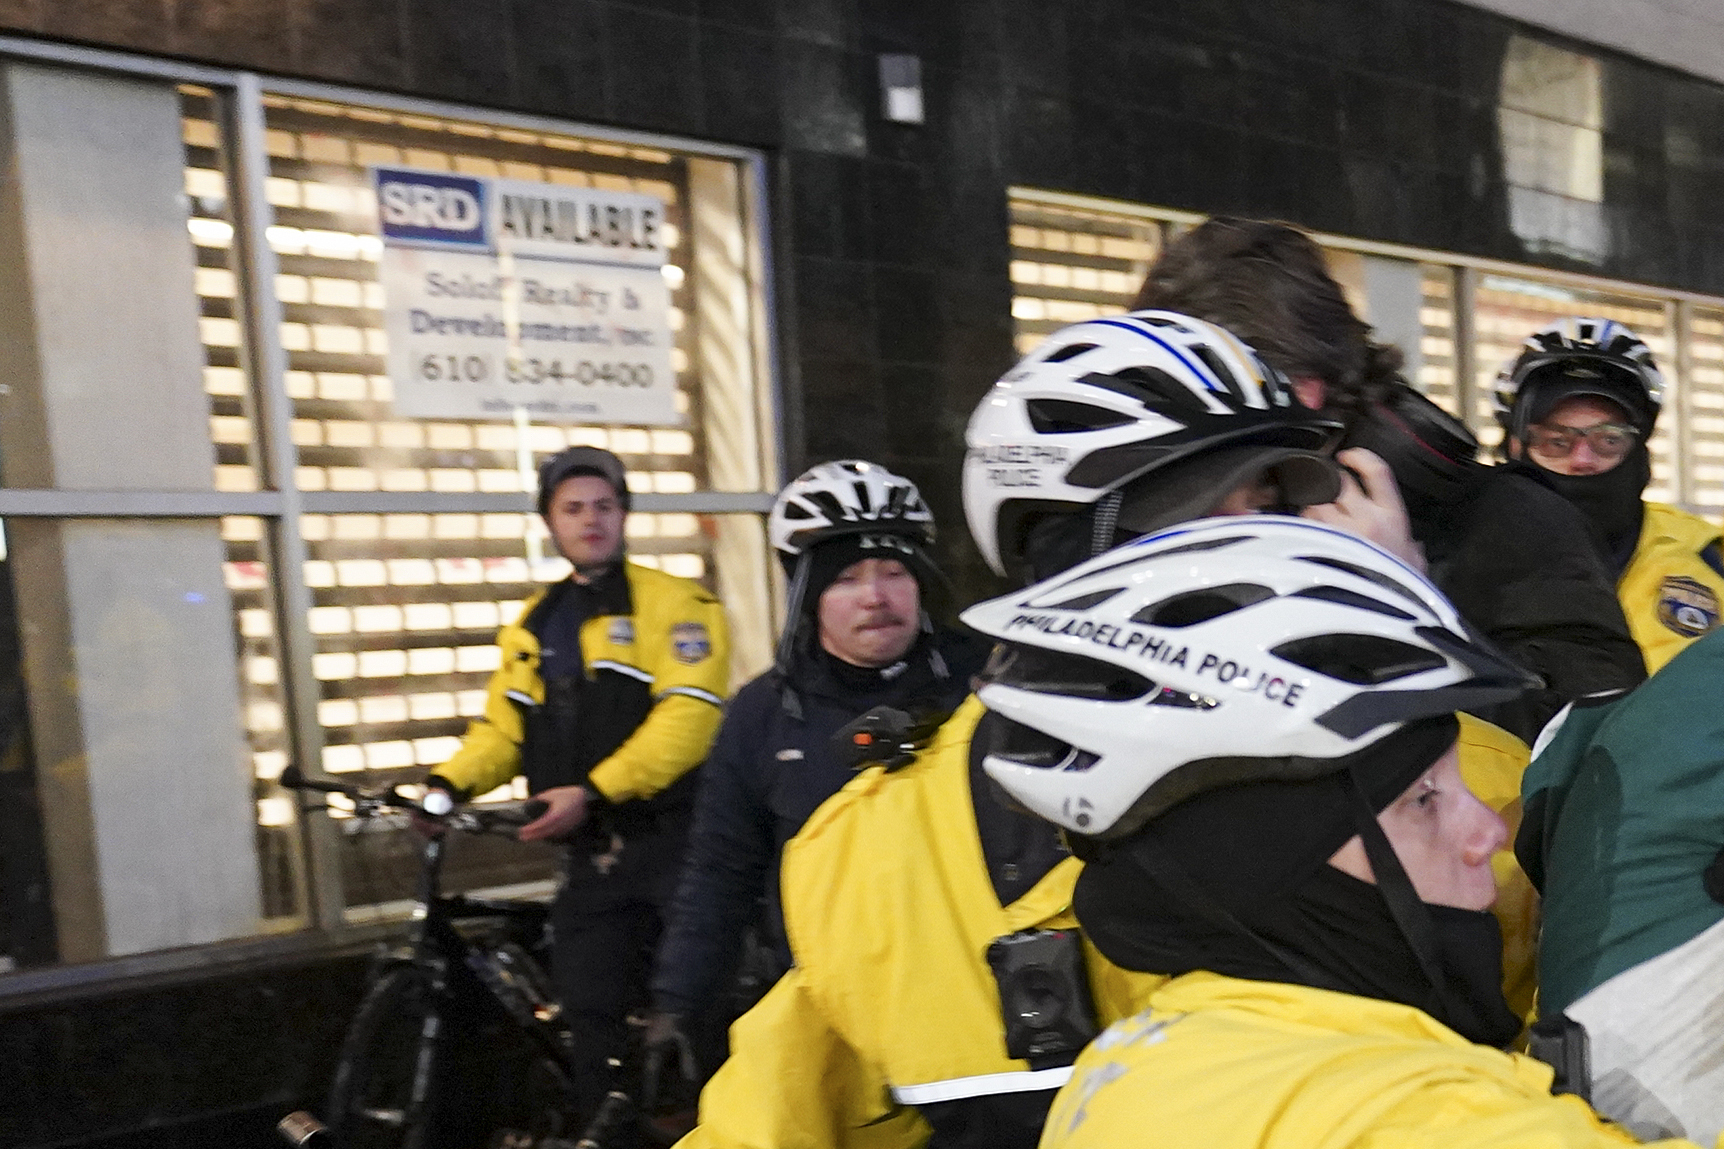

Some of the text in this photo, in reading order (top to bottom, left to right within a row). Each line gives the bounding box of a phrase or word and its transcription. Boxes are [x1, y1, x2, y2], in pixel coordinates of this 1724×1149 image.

[380, 181, 658, 251] SRD AVAILABLE
[1006, 613, 1190, 671] PHILADELPHIA
